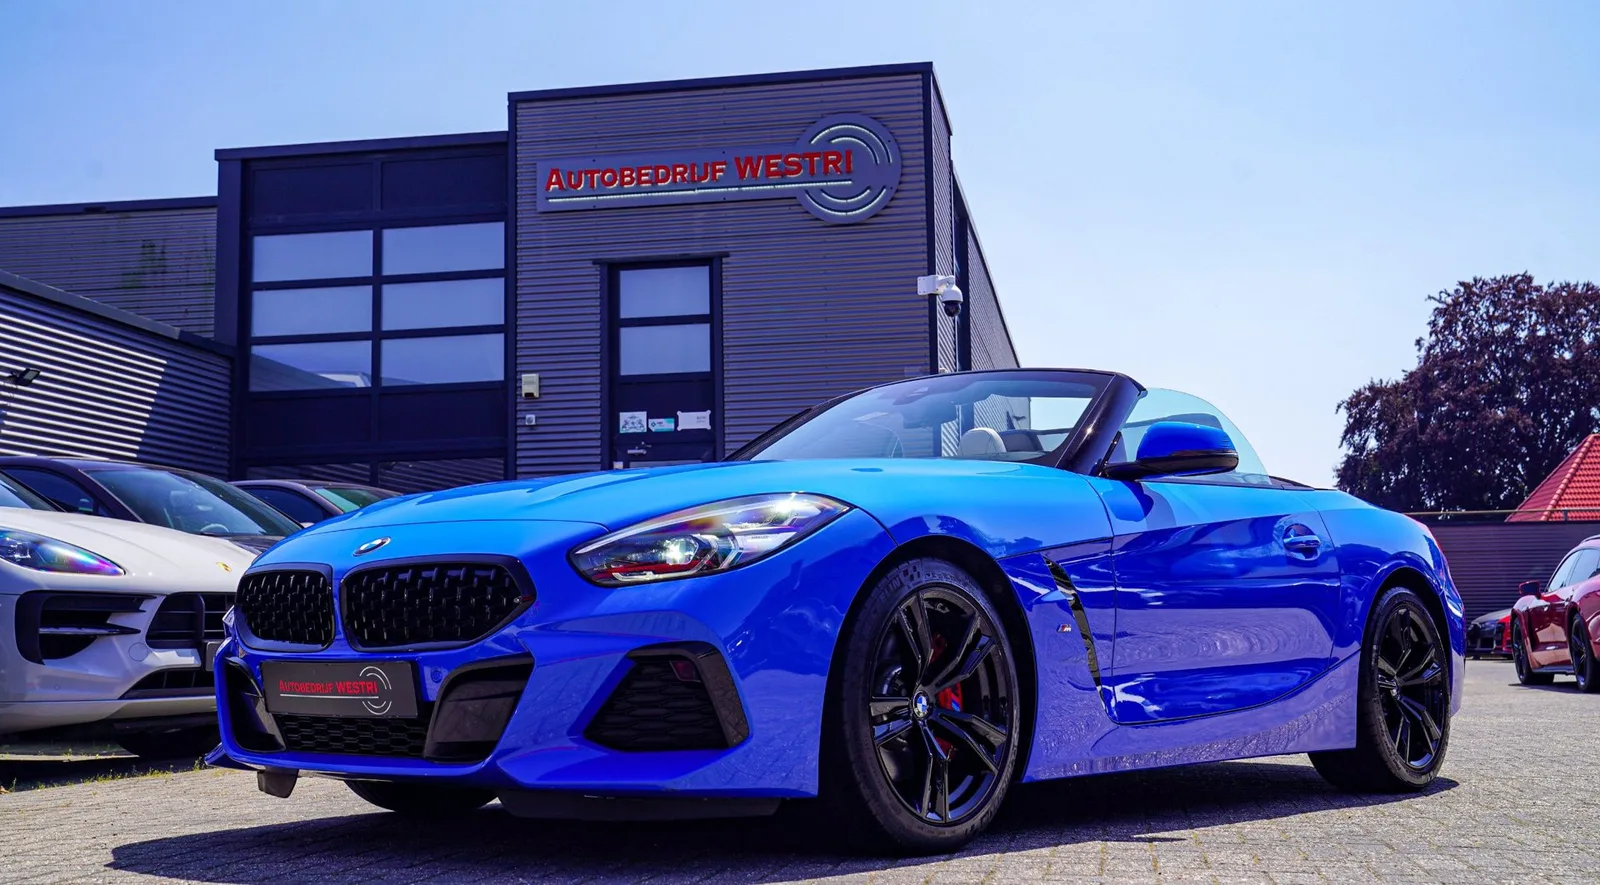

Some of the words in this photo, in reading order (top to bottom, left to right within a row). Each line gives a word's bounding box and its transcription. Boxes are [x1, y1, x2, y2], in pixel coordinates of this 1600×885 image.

[545, 160, 727, 192] AUTOBEDRIJF
[734, 150, 853, 180] WESTRI
[279, 680, 333, 693] AUTOBEDRIJF
[335, 681, 378, 695] WESTRI
